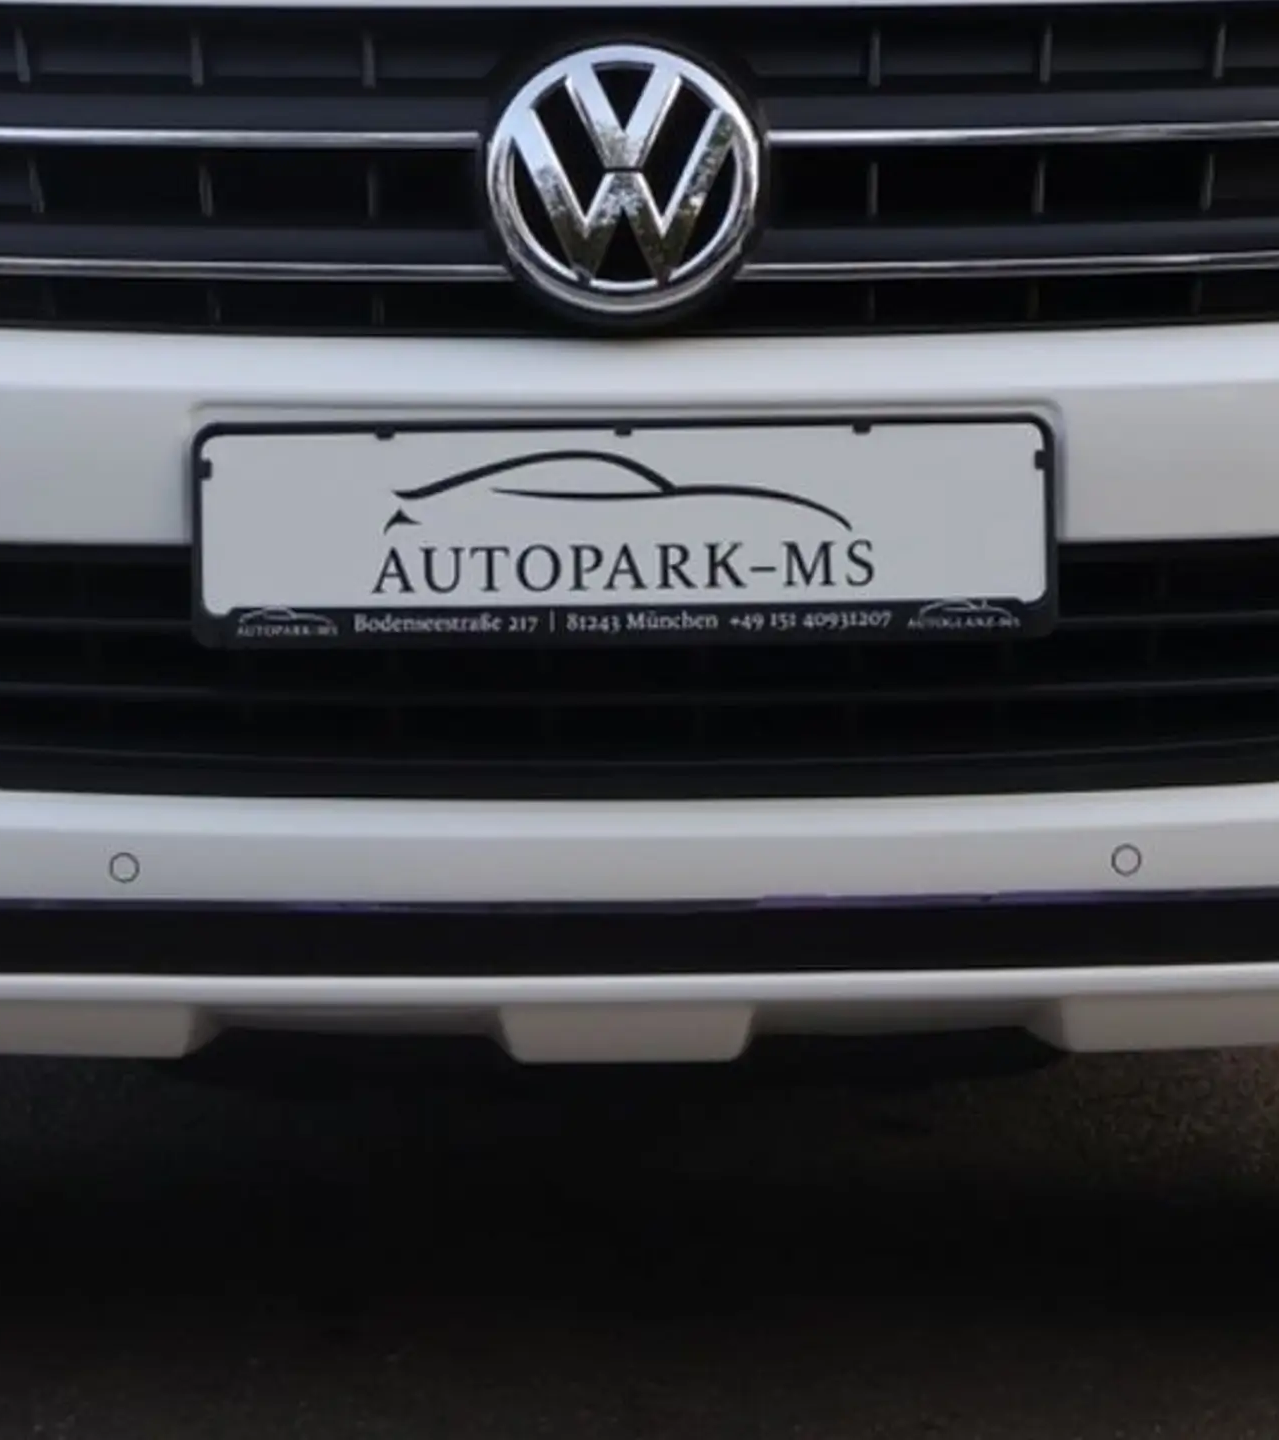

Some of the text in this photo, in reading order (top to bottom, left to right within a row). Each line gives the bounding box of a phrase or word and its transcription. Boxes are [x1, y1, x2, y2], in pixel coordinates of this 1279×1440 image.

[371, 538, 876, 594] AUTOPARK-MS
[353, 610, 893, 633] Bodenseestraße 217 81243 München +49 151 40931207
